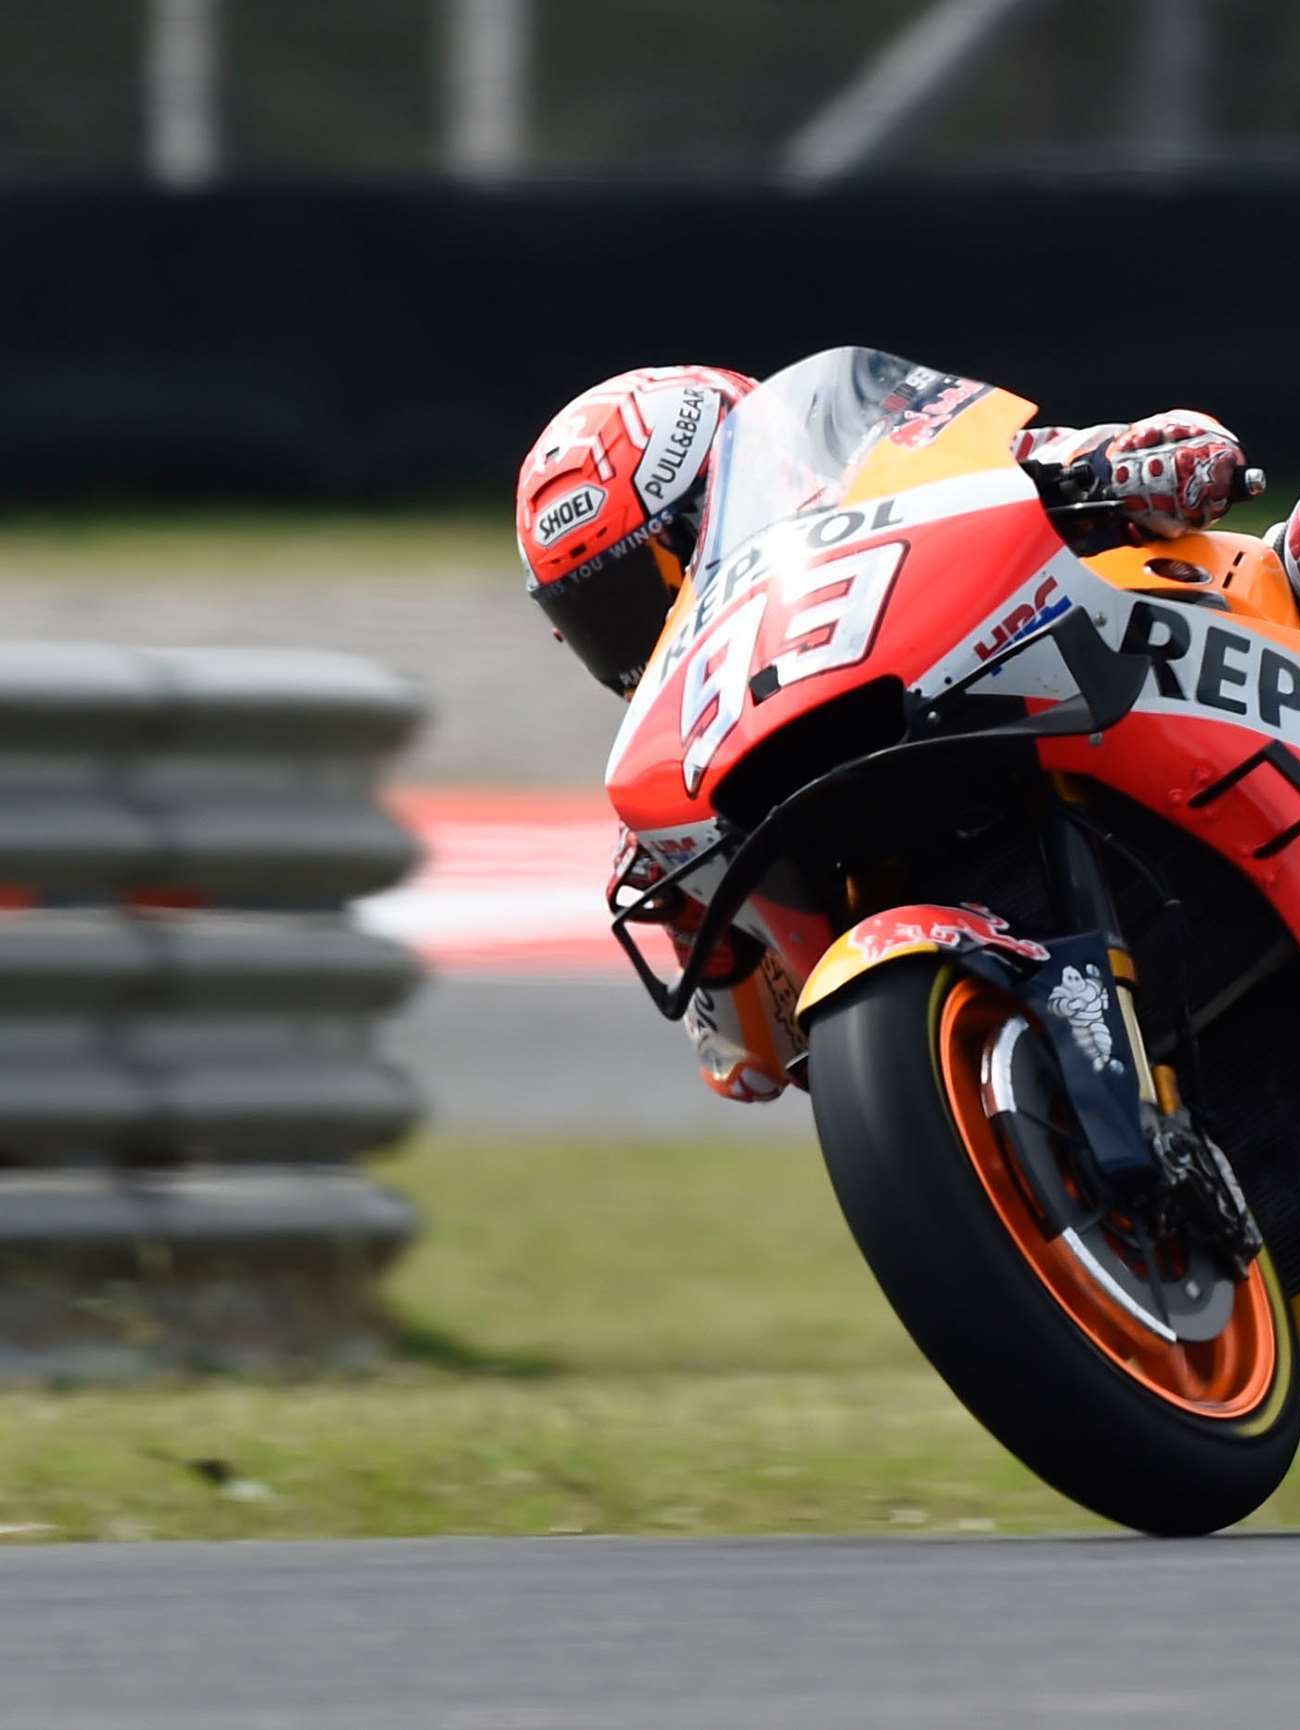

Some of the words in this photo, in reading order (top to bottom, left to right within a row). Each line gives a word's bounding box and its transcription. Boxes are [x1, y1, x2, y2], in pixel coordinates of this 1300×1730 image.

[645, 387, 705, 500] PULL&BEAR
[539, 491, 594, 540] SHOEI
[610, 510, 674, 559] WINGS
[659, 500, 904, 687] REPOL
[681, 540, 911, 800] 93
